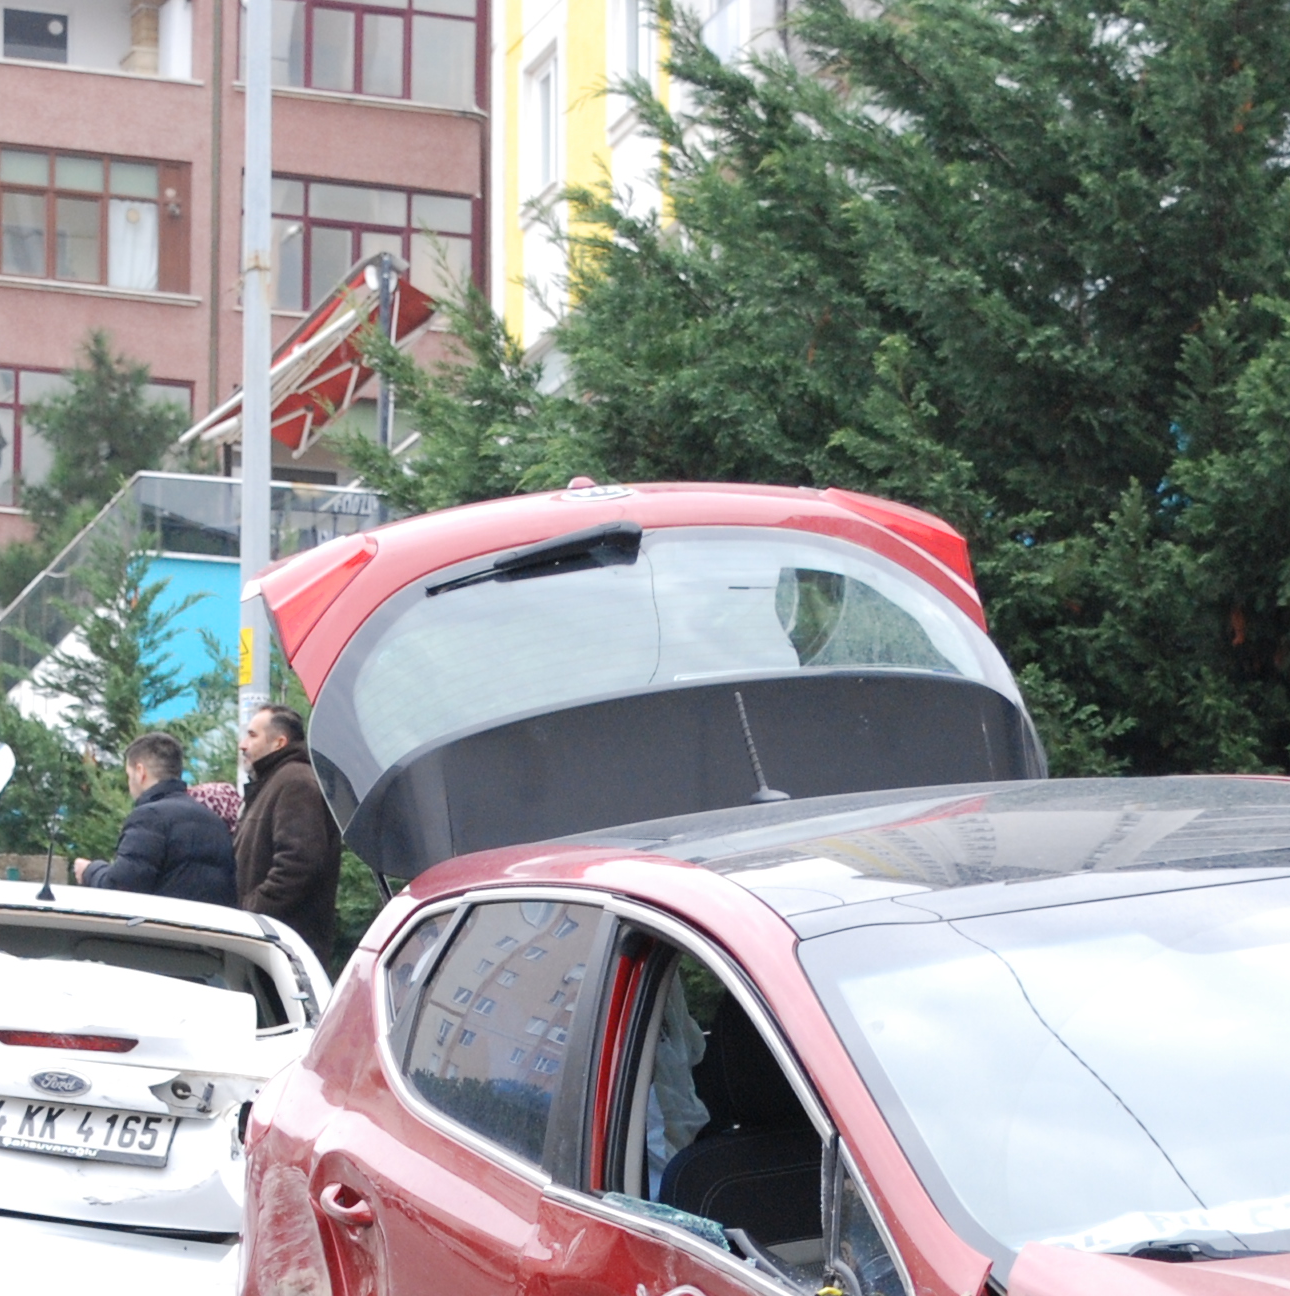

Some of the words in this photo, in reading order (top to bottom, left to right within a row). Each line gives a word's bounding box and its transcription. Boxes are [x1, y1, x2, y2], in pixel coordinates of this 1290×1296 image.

[39, 1072, 77, 1092] Ford
[17, 1104, 66, 1140] KK
[76, 1111, 162, 1151] 4165
